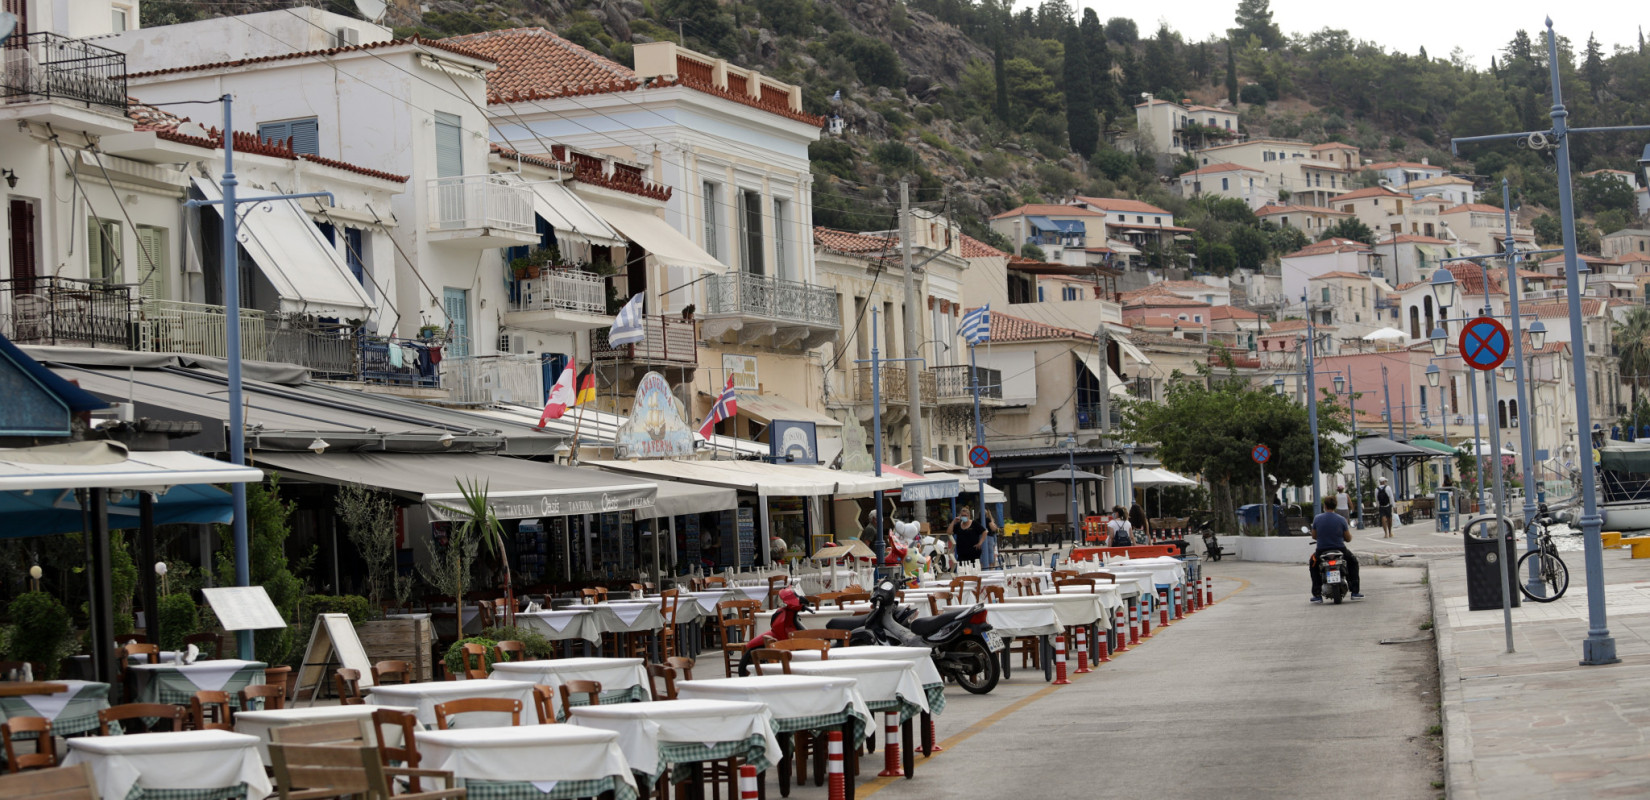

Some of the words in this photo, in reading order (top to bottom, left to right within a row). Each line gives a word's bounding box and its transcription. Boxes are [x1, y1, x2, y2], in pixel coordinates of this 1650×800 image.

[637, 376, 672, 407] CARAVELLA
[641, 440, 673, 453] TAVERNA
[505, 504, 535, 516] TAVERNA
[567, 500, 595, 512] TAVERNA
